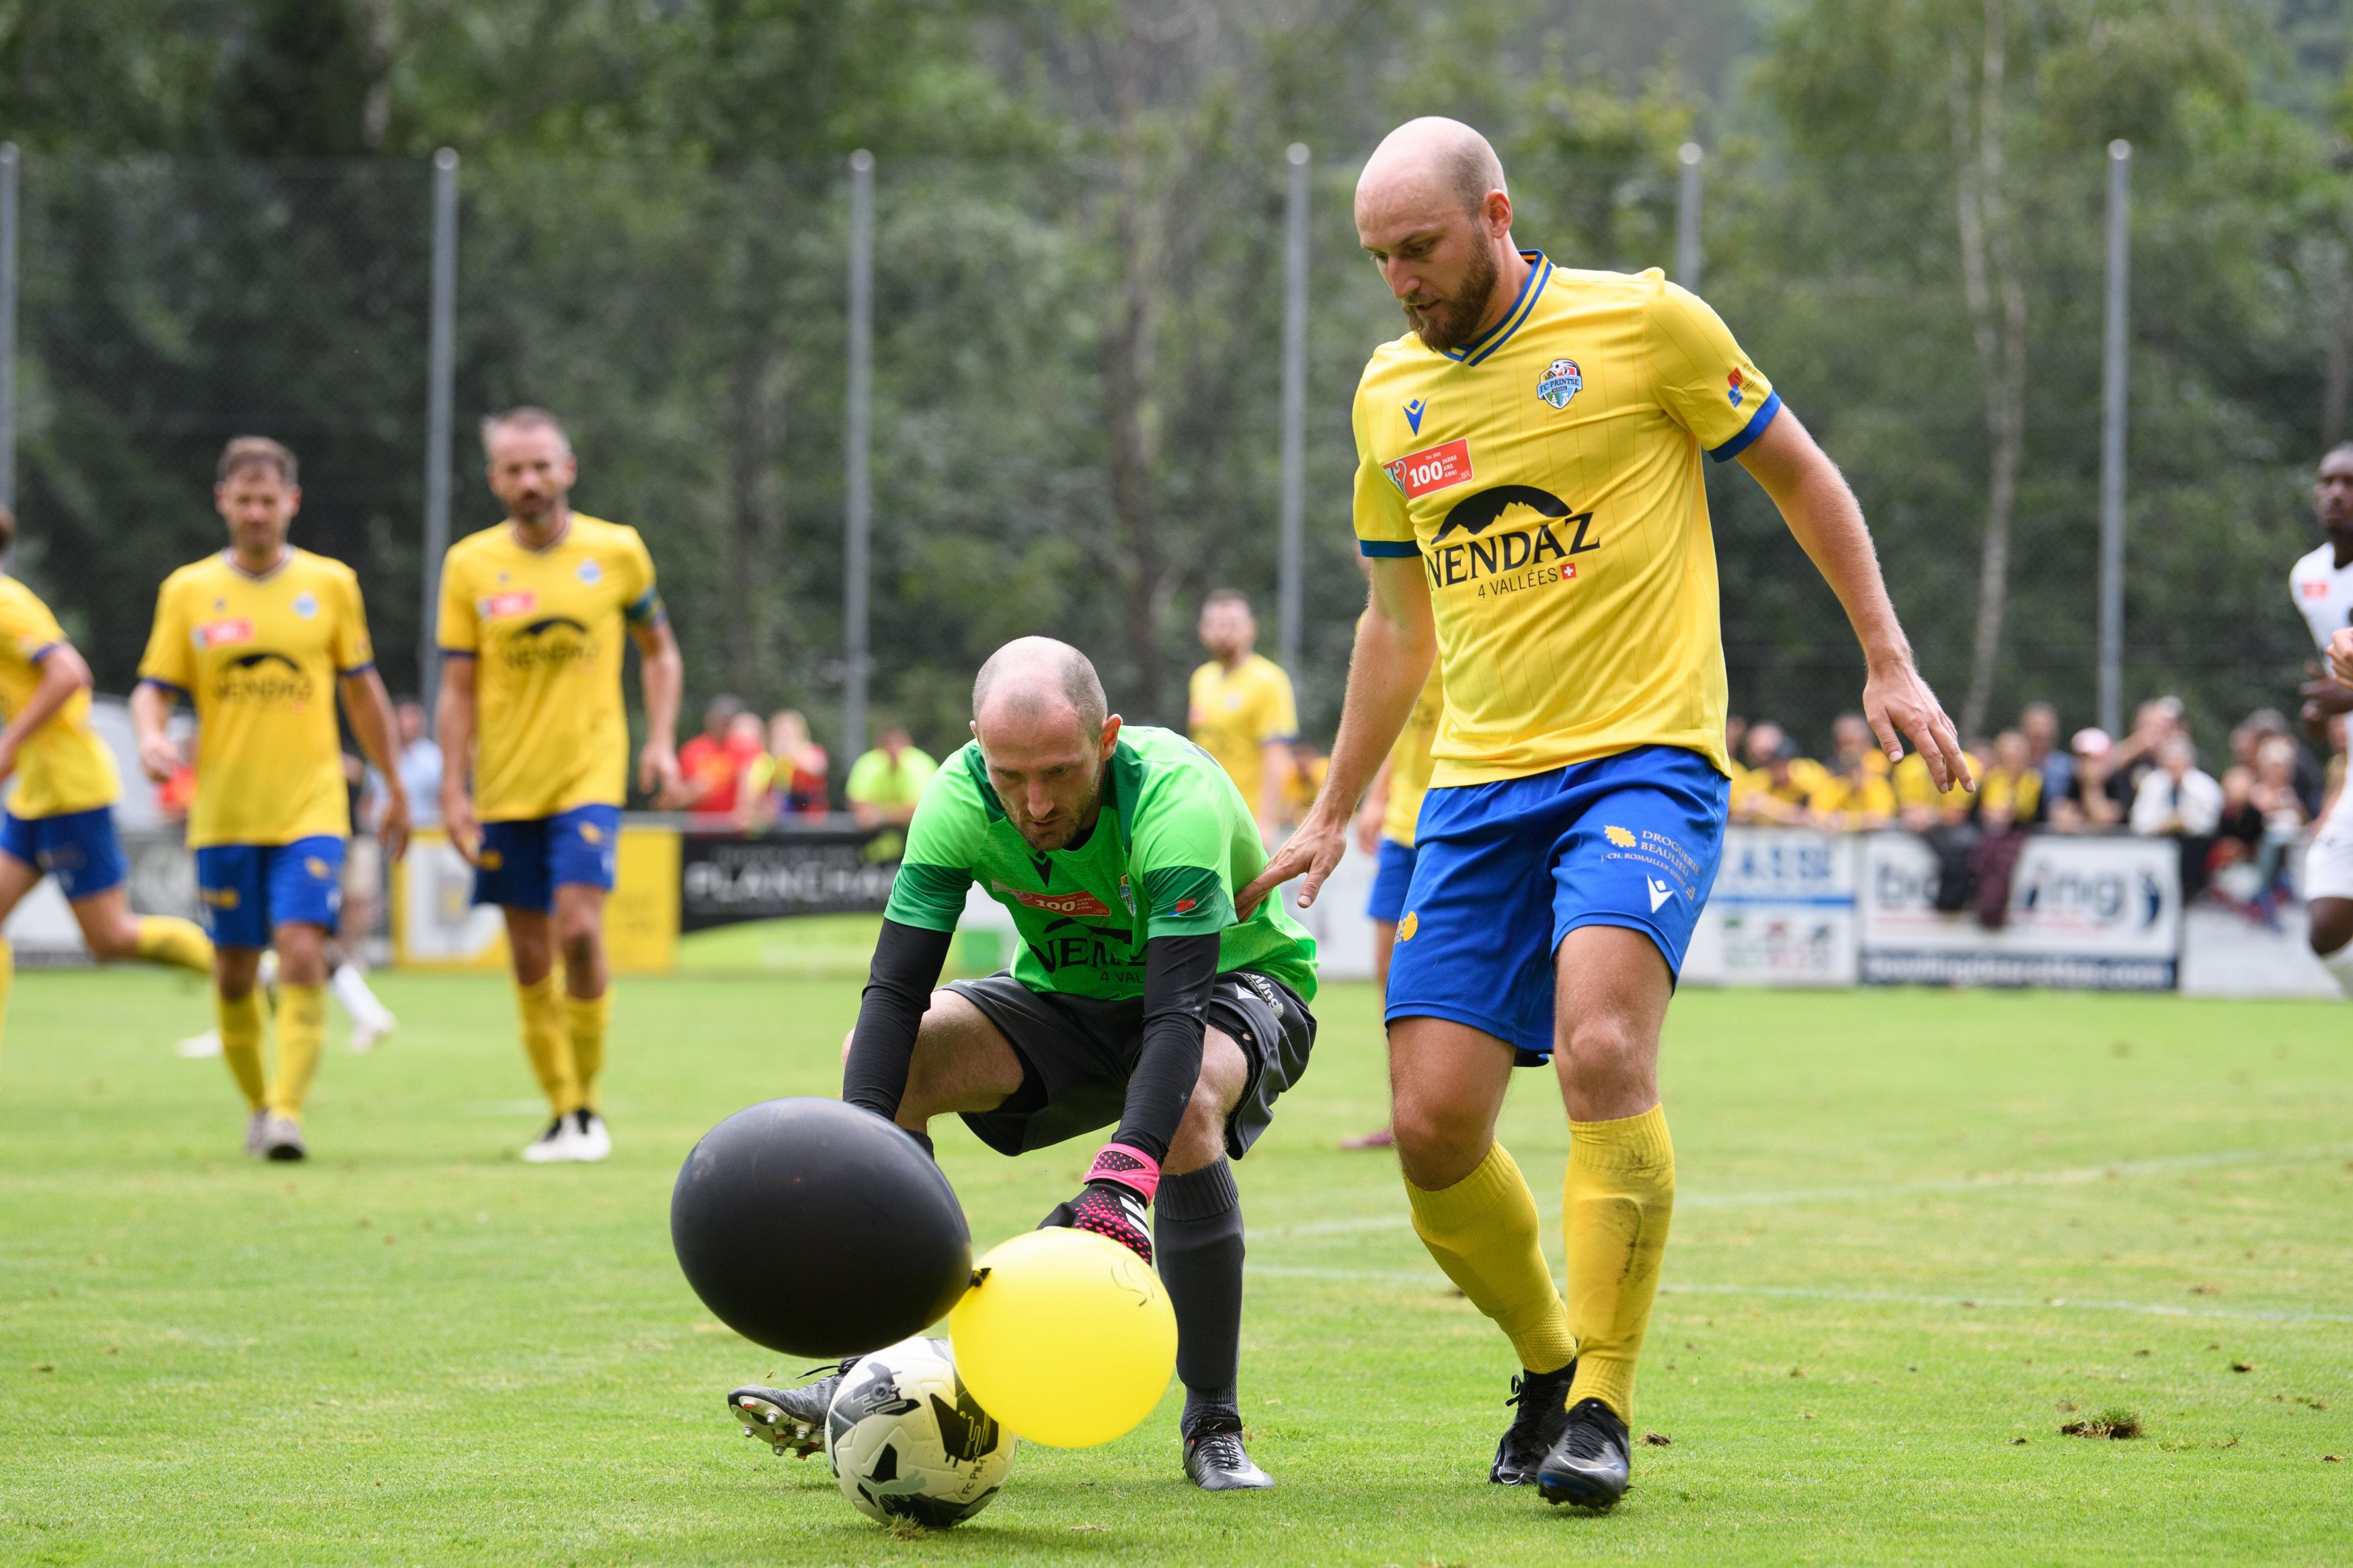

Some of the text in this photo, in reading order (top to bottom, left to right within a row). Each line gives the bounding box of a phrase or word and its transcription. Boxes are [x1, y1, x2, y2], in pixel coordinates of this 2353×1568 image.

[1540, 378, 1580, 393] FC PRINTSE
[1441, 454, 1458, 465] JAHRE
[1443, 463, 1453, 471] ANS
[1409, 460, 1443, 488] 100
[1445, 469, 1458, 478] ANNI
[1425, 511, 1601, 592] NENDAZ
[1478, 567, 1558, 599] 4 VALLÉES
[1640, 841, 1689, 877] BEAULIEU
[1642, 830, 1701, 876] DROGUERIE
[1624, 852, 1670, 872] ROMAILLER
[1035, 900, 1076, 912] 100
[1100, 971, 1144, 984] 4 VAL
[961, 1483, 975, 1495] FC
